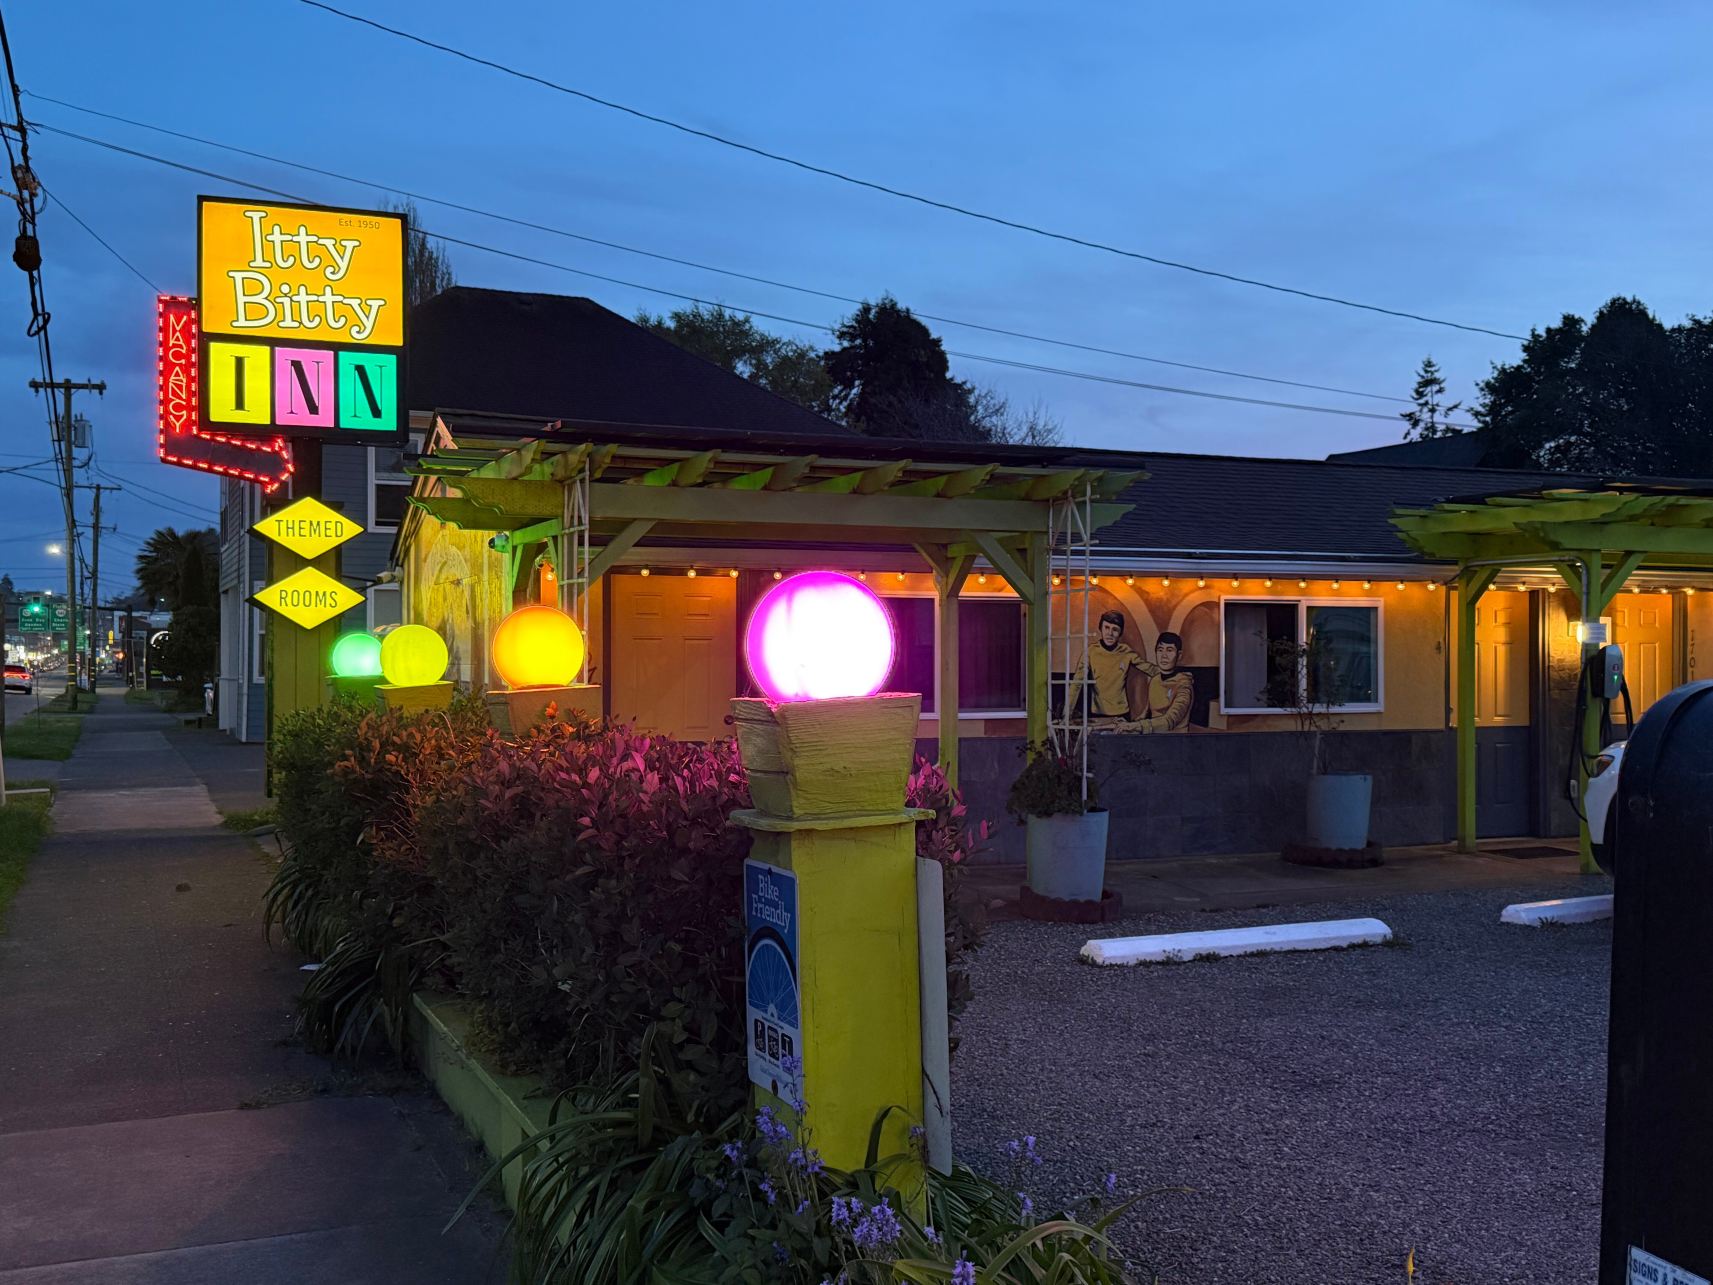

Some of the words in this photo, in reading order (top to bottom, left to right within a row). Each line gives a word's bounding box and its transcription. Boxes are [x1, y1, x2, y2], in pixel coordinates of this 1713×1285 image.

[338, 218, 354, 228] Est.
[358, 219, 380, 230] 1950
[244, 210, 361, 281] Itty
[227, 270, 386, 340] Bitty
[169, 314, 187, 433] VACANCY
[230, 355, 388, 419] INN
[275, 519, 344, 538] THEMED
[279, 589, 338, 608] ROOMS
[758, 874, 779, 901] Bike
[752, 894, 791, 933] Friendly
[1632, 1259, 1659, 1283] SIGNS
